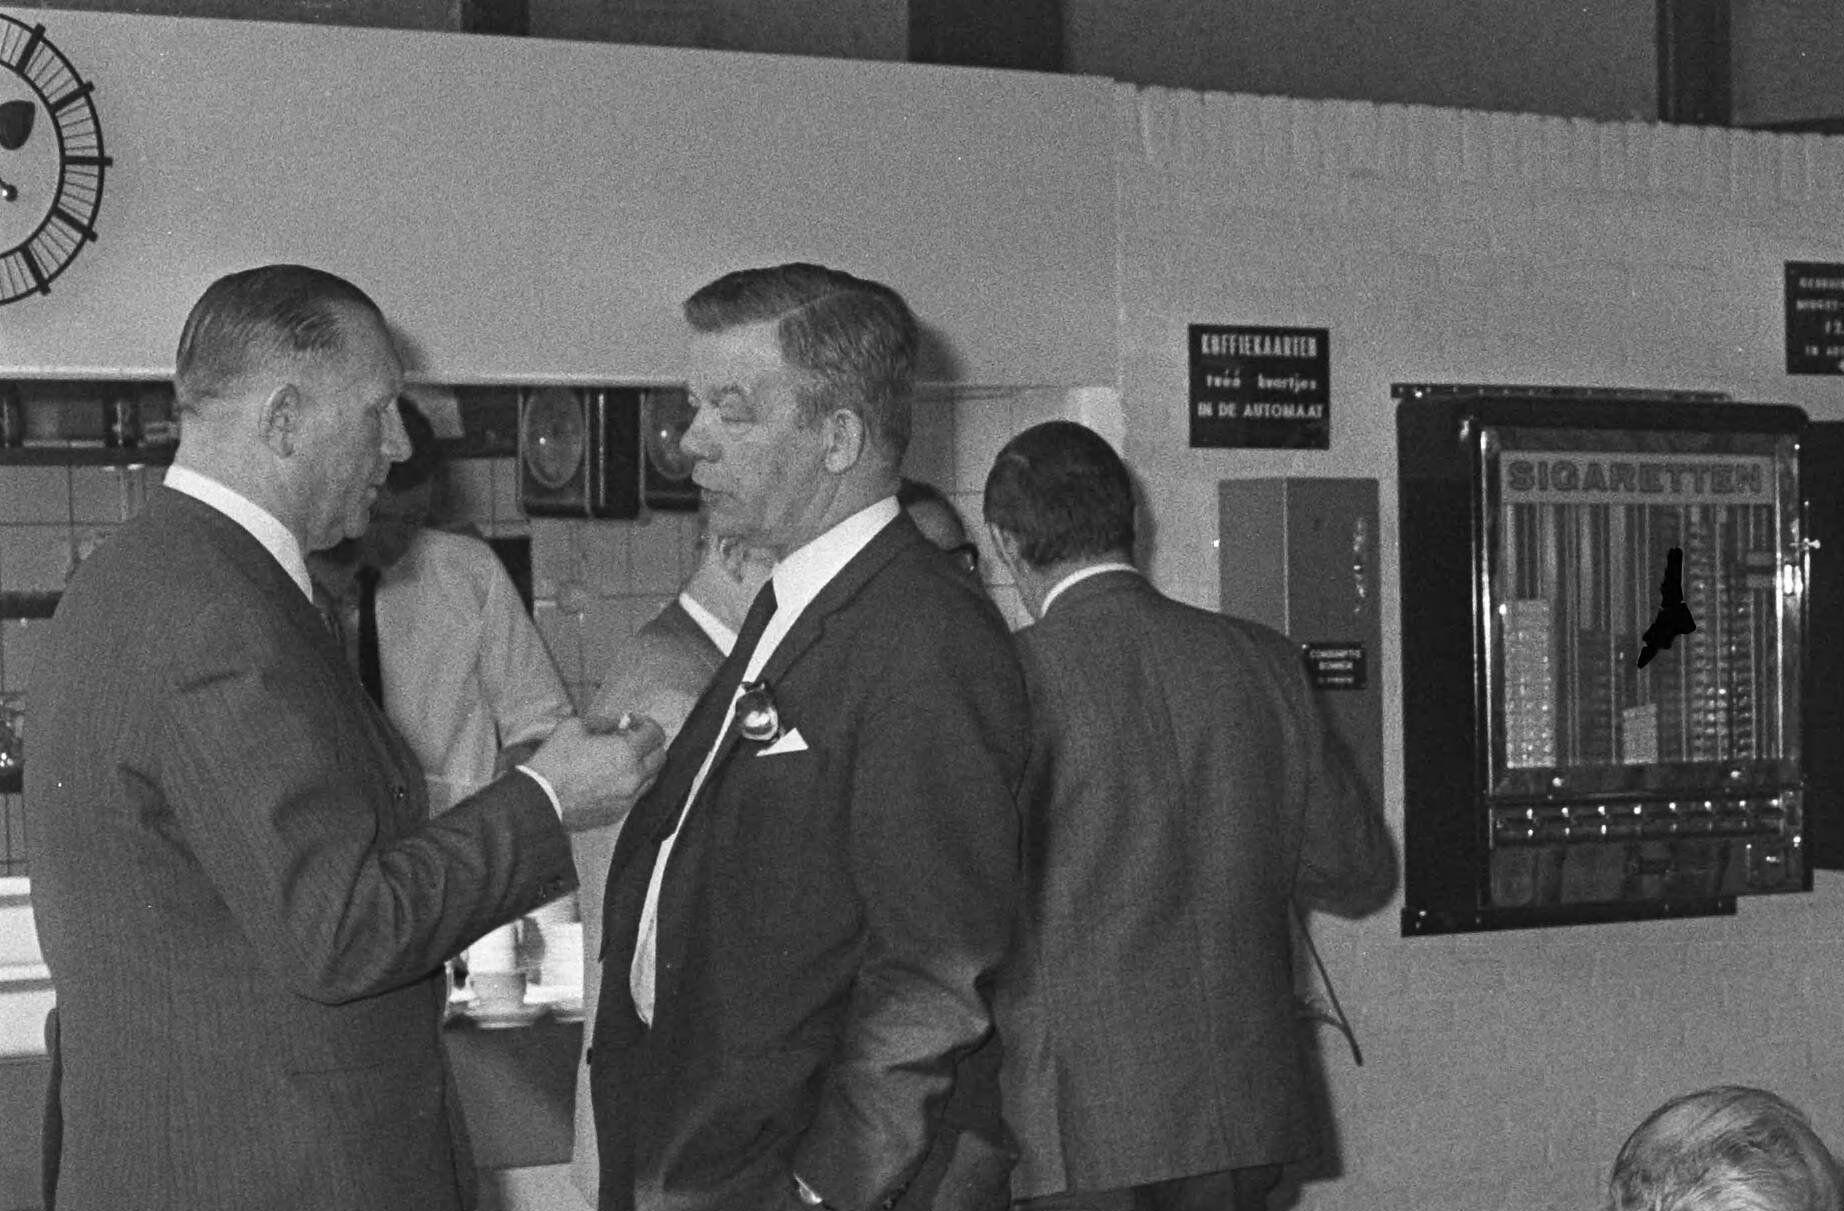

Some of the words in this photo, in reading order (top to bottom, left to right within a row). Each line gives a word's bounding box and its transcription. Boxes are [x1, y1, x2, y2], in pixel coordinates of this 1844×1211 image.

[1200, 333, 1318, 357] KOFFIEKAARTEN
[1197, 401, 1213, 417] IN
[1218, 402, 1237, 418] DE
[1243, 402, 1323, 419] AUTOMAAT
[1507, 460, 1763, 494] SIGARETTEN
